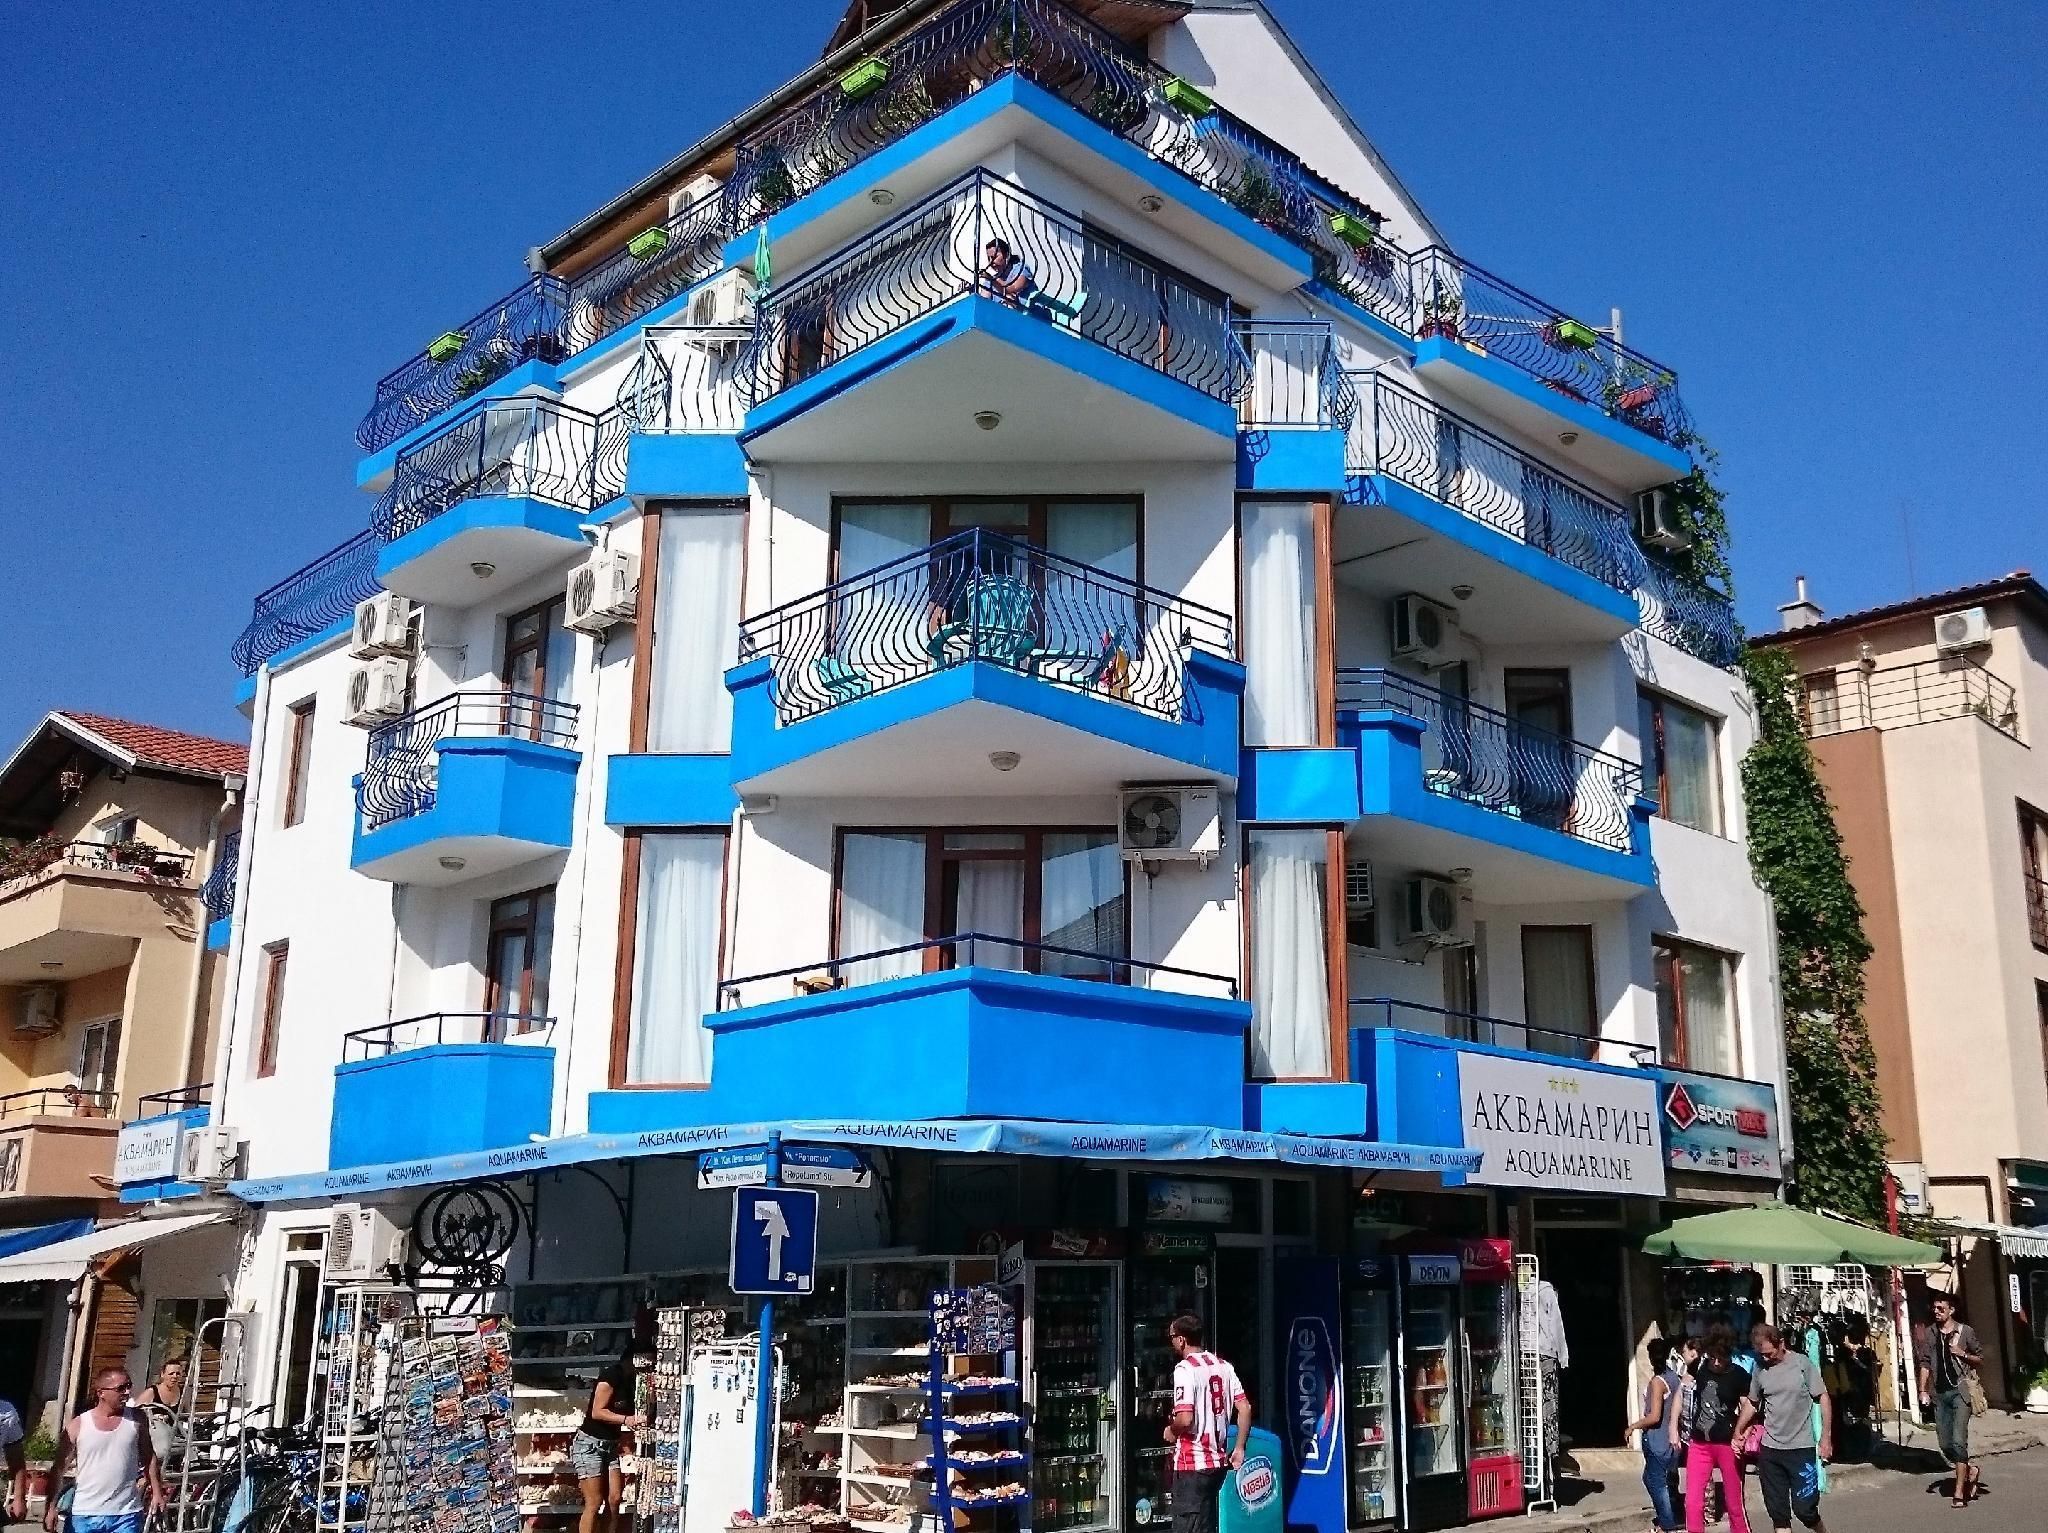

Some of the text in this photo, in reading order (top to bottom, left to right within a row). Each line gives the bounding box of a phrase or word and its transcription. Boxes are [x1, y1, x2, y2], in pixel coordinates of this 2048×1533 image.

[1471, 1091, 1653, 1148] АКВАМАРИН
[637, 1127, 728, 1148] АКВАМАРИН
[834, 1124, 957, 1142] AQUAMARINE
[1071, 1136, 1147, 1152] AQUAMARINE
[1210, 1138, 1275, 1153] АКВАМАРИН
[1292, 1143, 1354, 1160] AQUAMARINE
[488, 1146, 548, 1167] AQUAMARINE
[1504, 1148, 1633, 1182] AQUAMARINE
[2011, 1276, 2019, 1311] TATTOO
[1209, 1374, 1225, 1415] 8
